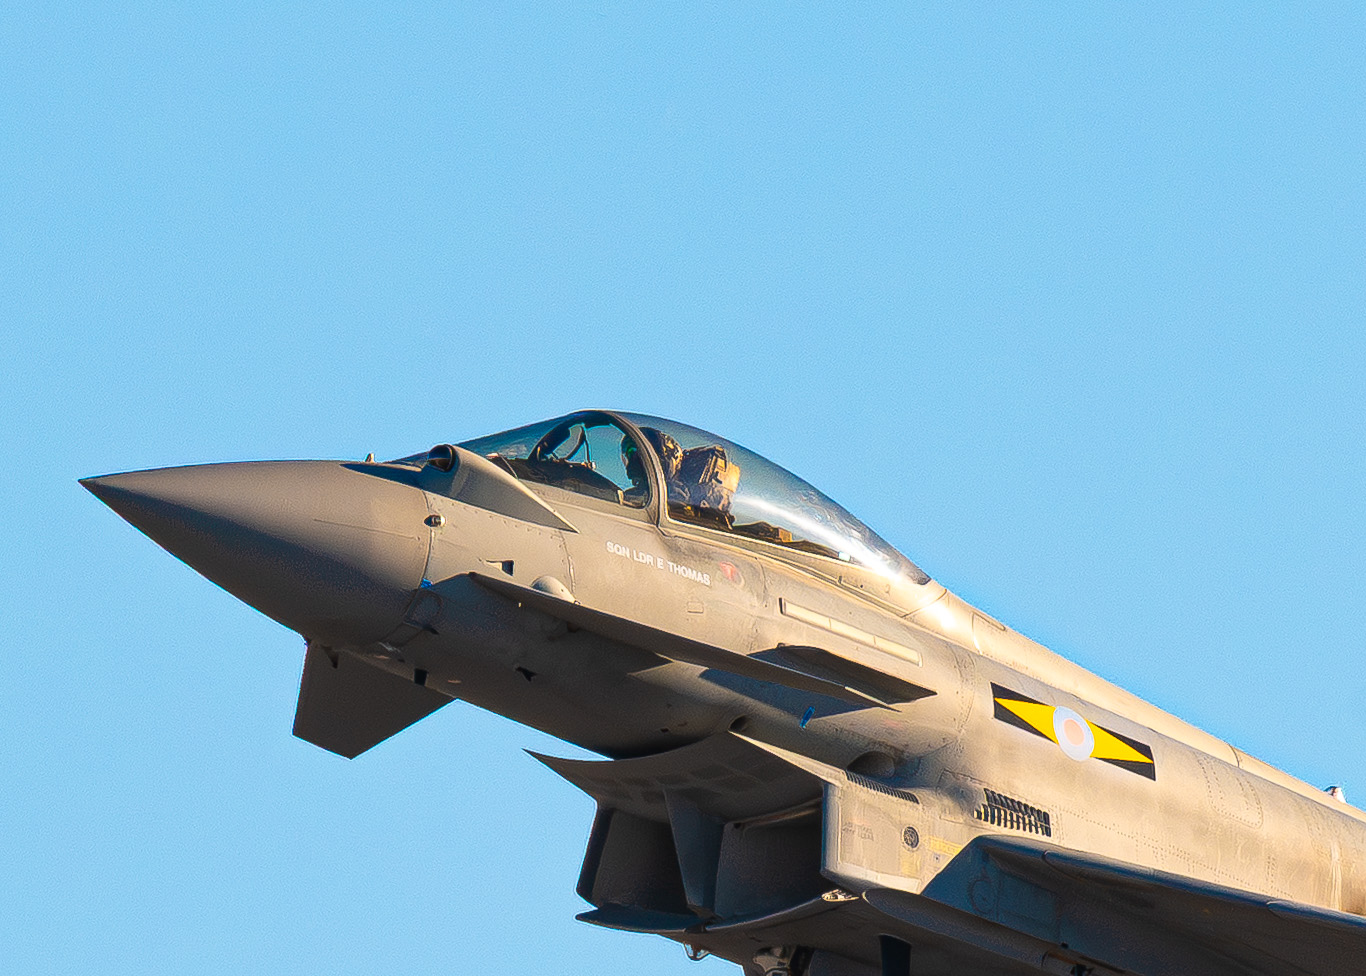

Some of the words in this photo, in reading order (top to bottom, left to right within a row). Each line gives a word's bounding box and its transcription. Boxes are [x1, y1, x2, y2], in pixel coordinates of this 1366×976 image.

[606, 541, 630, 558] SQN
[633, 550, 654, 566] LDR
[657, 558, 664, 570] E
[667, 561, 711, 585] THOMAS
